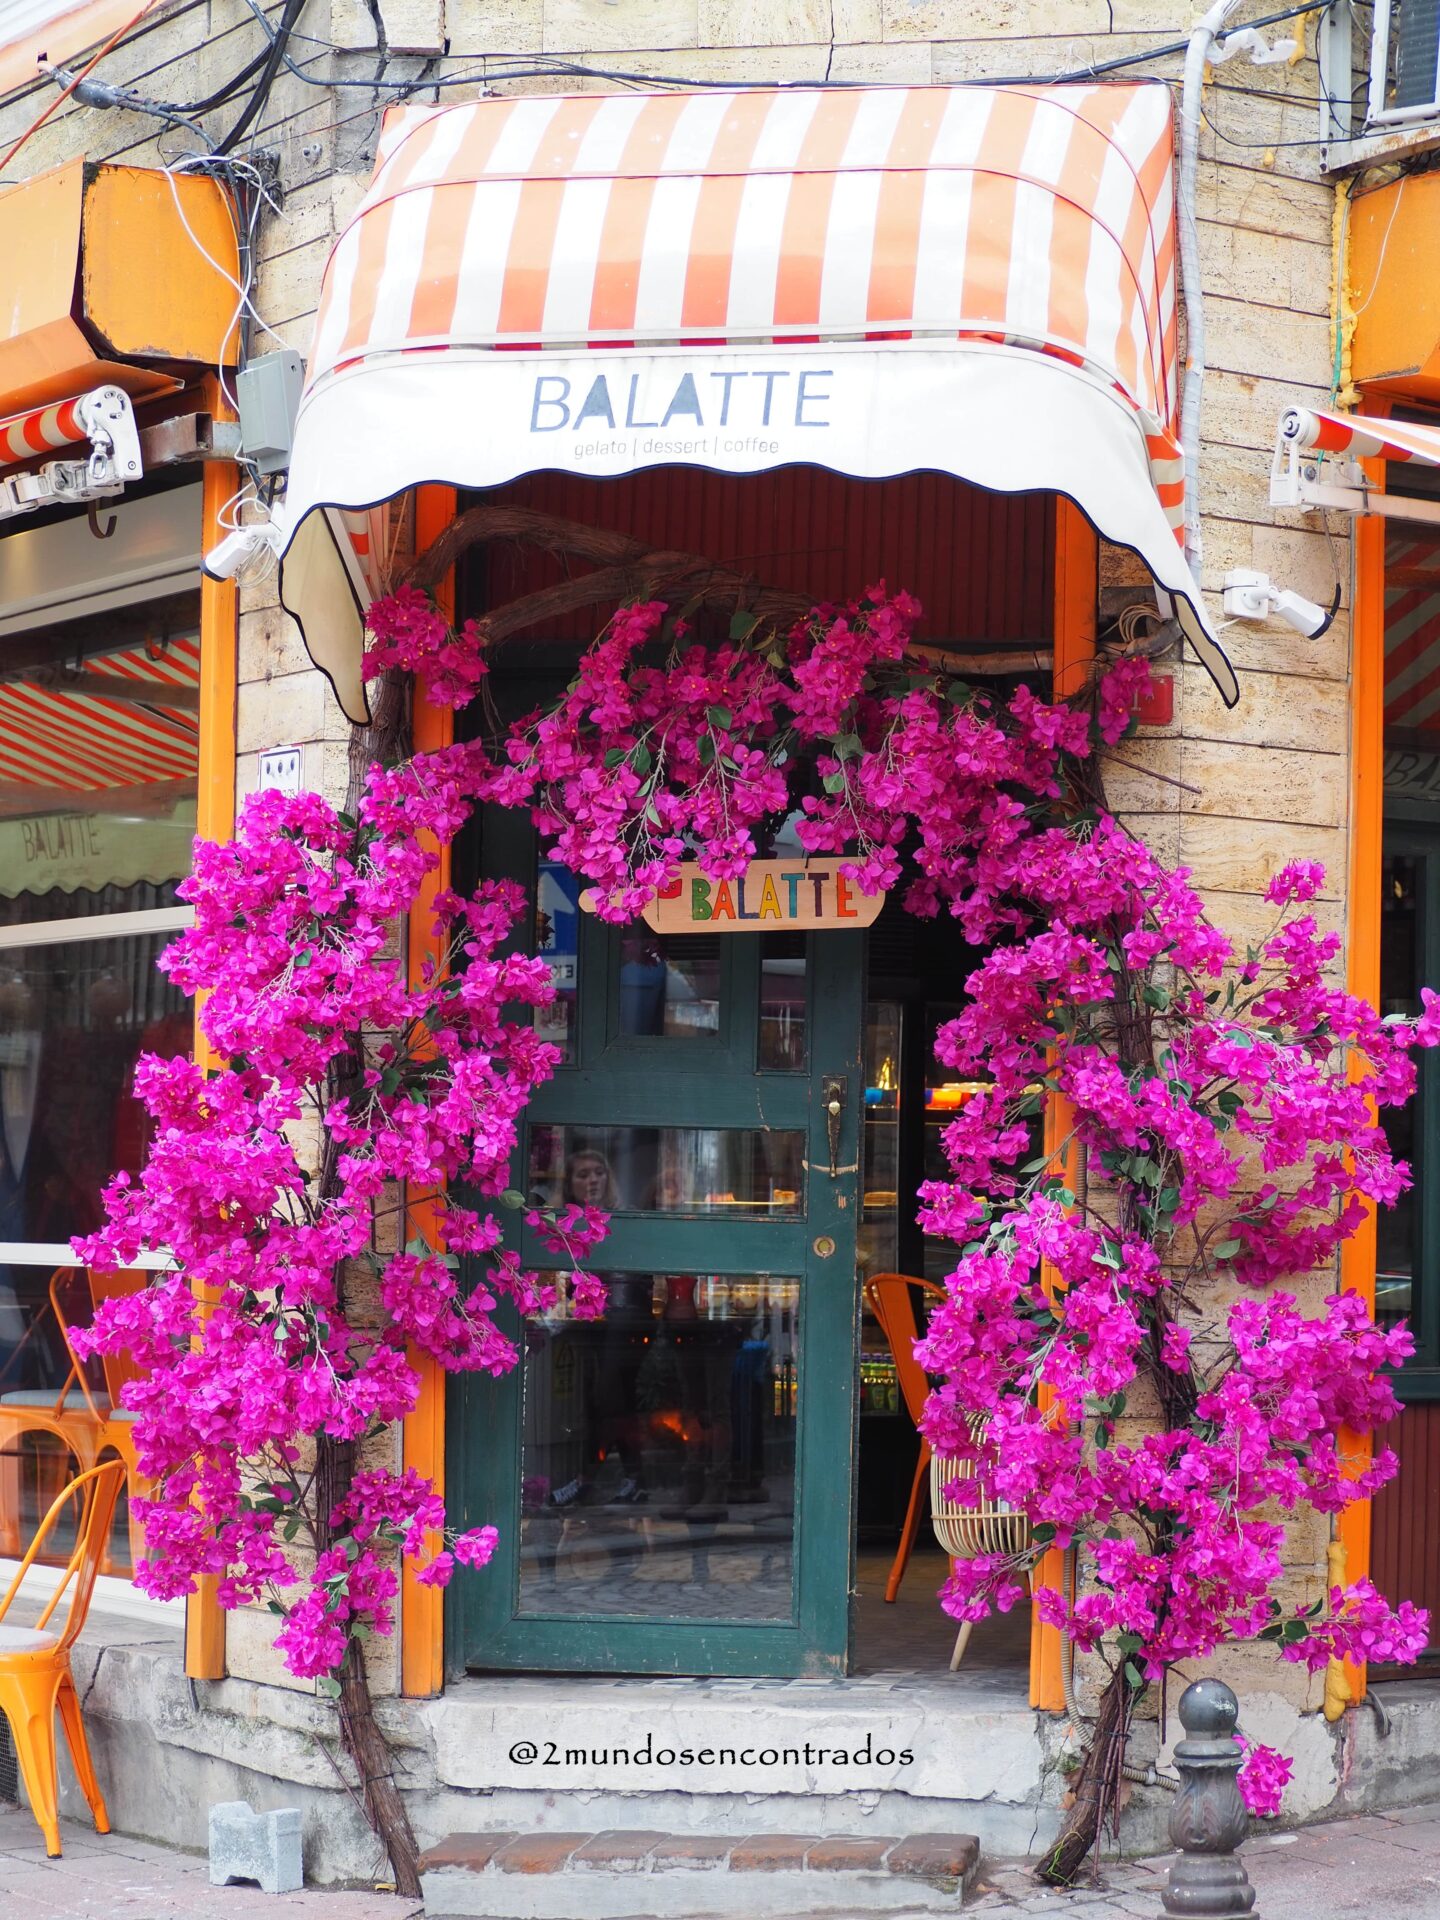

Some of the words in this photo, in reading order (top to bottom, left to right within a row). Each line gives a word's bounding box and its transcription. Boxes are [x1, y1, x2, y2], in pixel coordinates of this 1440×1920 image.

[529, 370, 834, 433] BALATTE
[573, 440, 628, 460] gelato
[643, 438, 708, 455] dessert
[723, 436, 780, 454] coffee
[1384, 752, 1440, 792] BA
[20, 813, 101, 863] BALATTE
[691, 872, 858, 921] BALATTE
